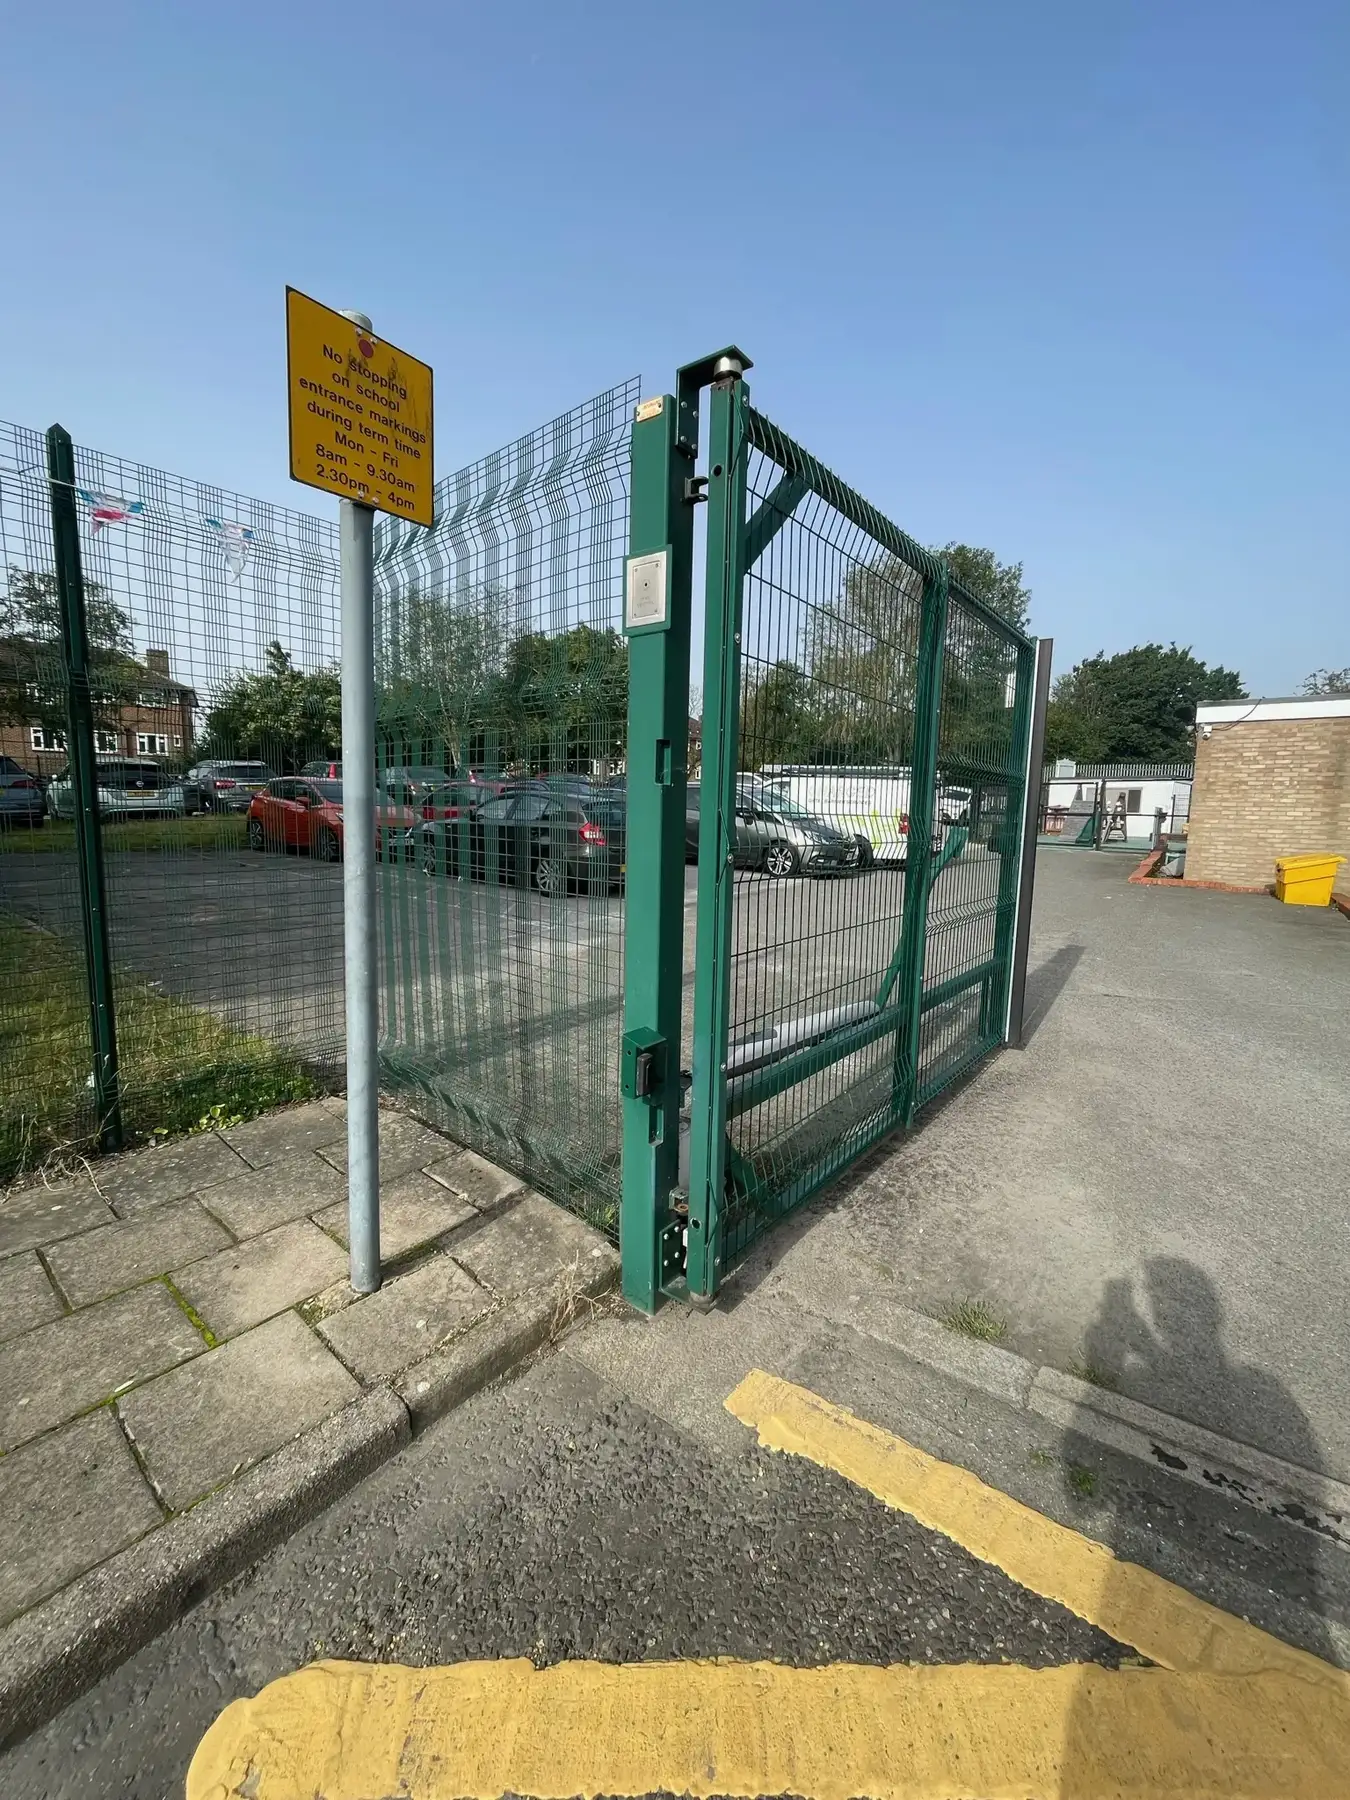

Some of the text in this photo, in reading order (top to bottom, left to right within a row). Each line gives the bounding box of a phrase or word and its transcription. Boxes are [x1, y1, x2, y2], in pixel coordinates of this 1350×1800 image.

[323, 344, 407, 400] No stopping
[332, 373, 400, 412] on school
[300, 377, 426, 443] entrance markings
[307, 401, 421, 459] during term time
[316, 443, 347, 466] 8am
[367, 463, 415, 493] 9.30am
[335, 430, 364, 453] Mon
[383, 451, 399, 467] Fri
[316, 463, 369, 493] 2.30pm
[388, 491, 415, 511] 4pm
